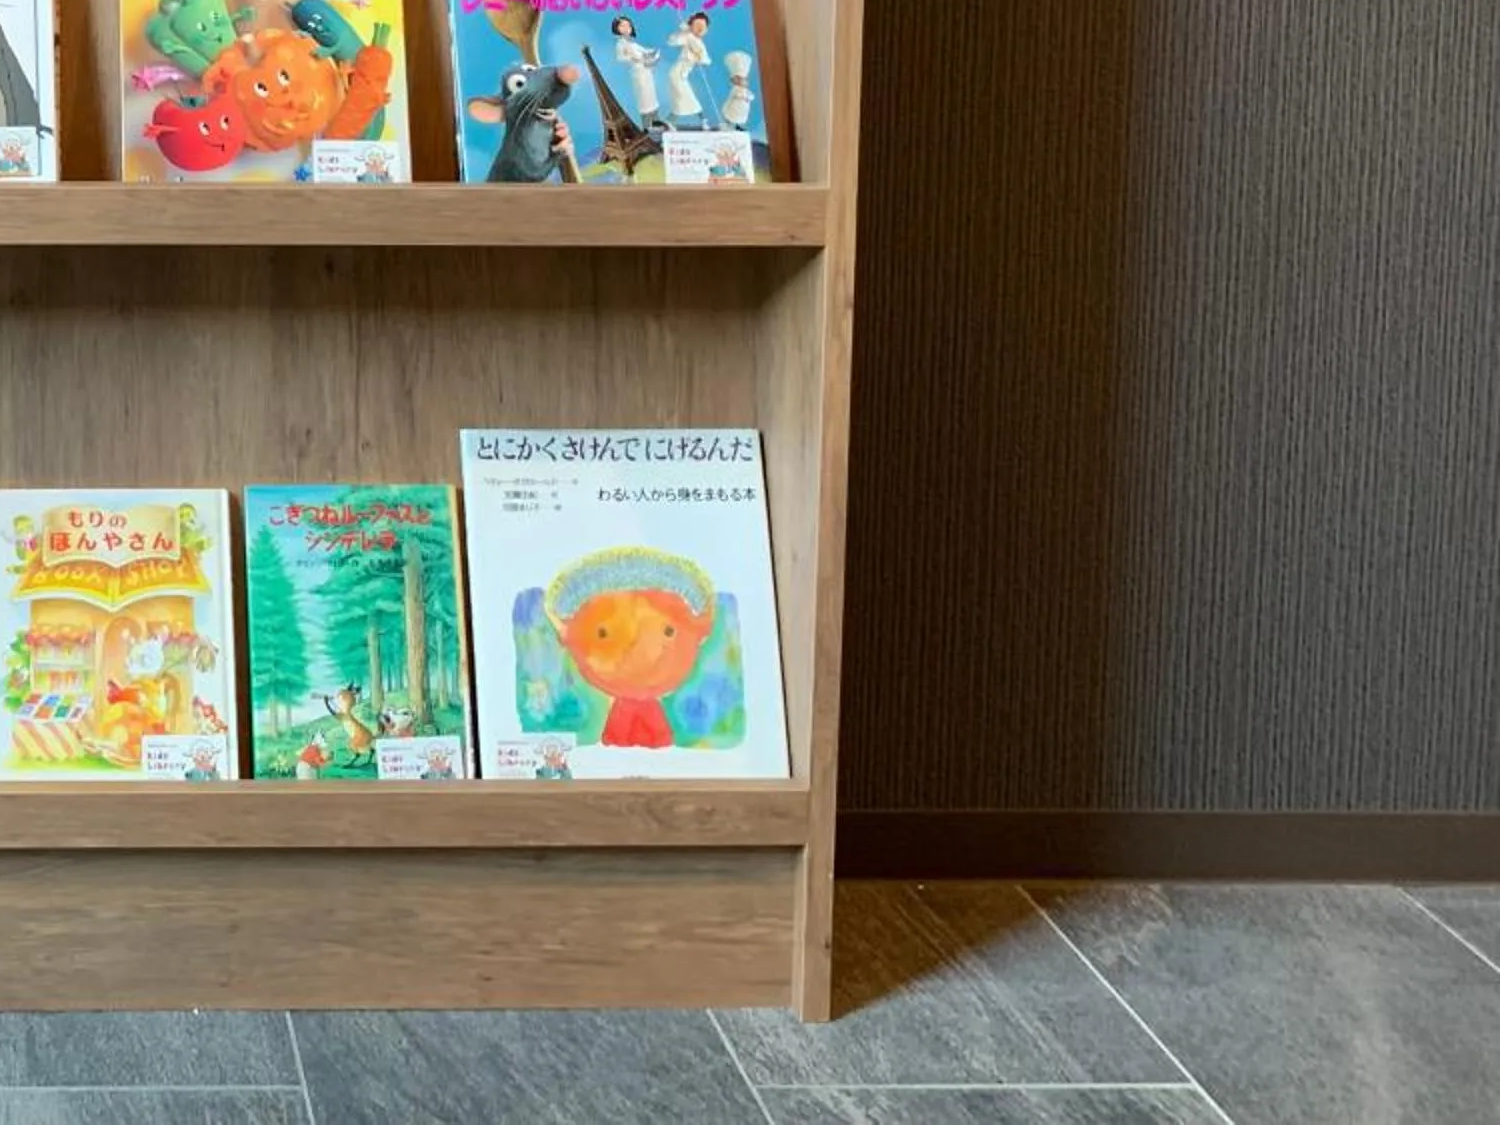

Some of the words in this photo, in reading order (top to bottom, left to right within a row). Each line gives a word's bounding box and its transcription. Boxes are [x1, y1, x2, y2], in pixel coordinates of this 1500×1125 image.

[68, 510, 128, 529] もりの
[50, 531, 173, 552] ほんやさん
[306, 530, 400, 552] シンデレラ
